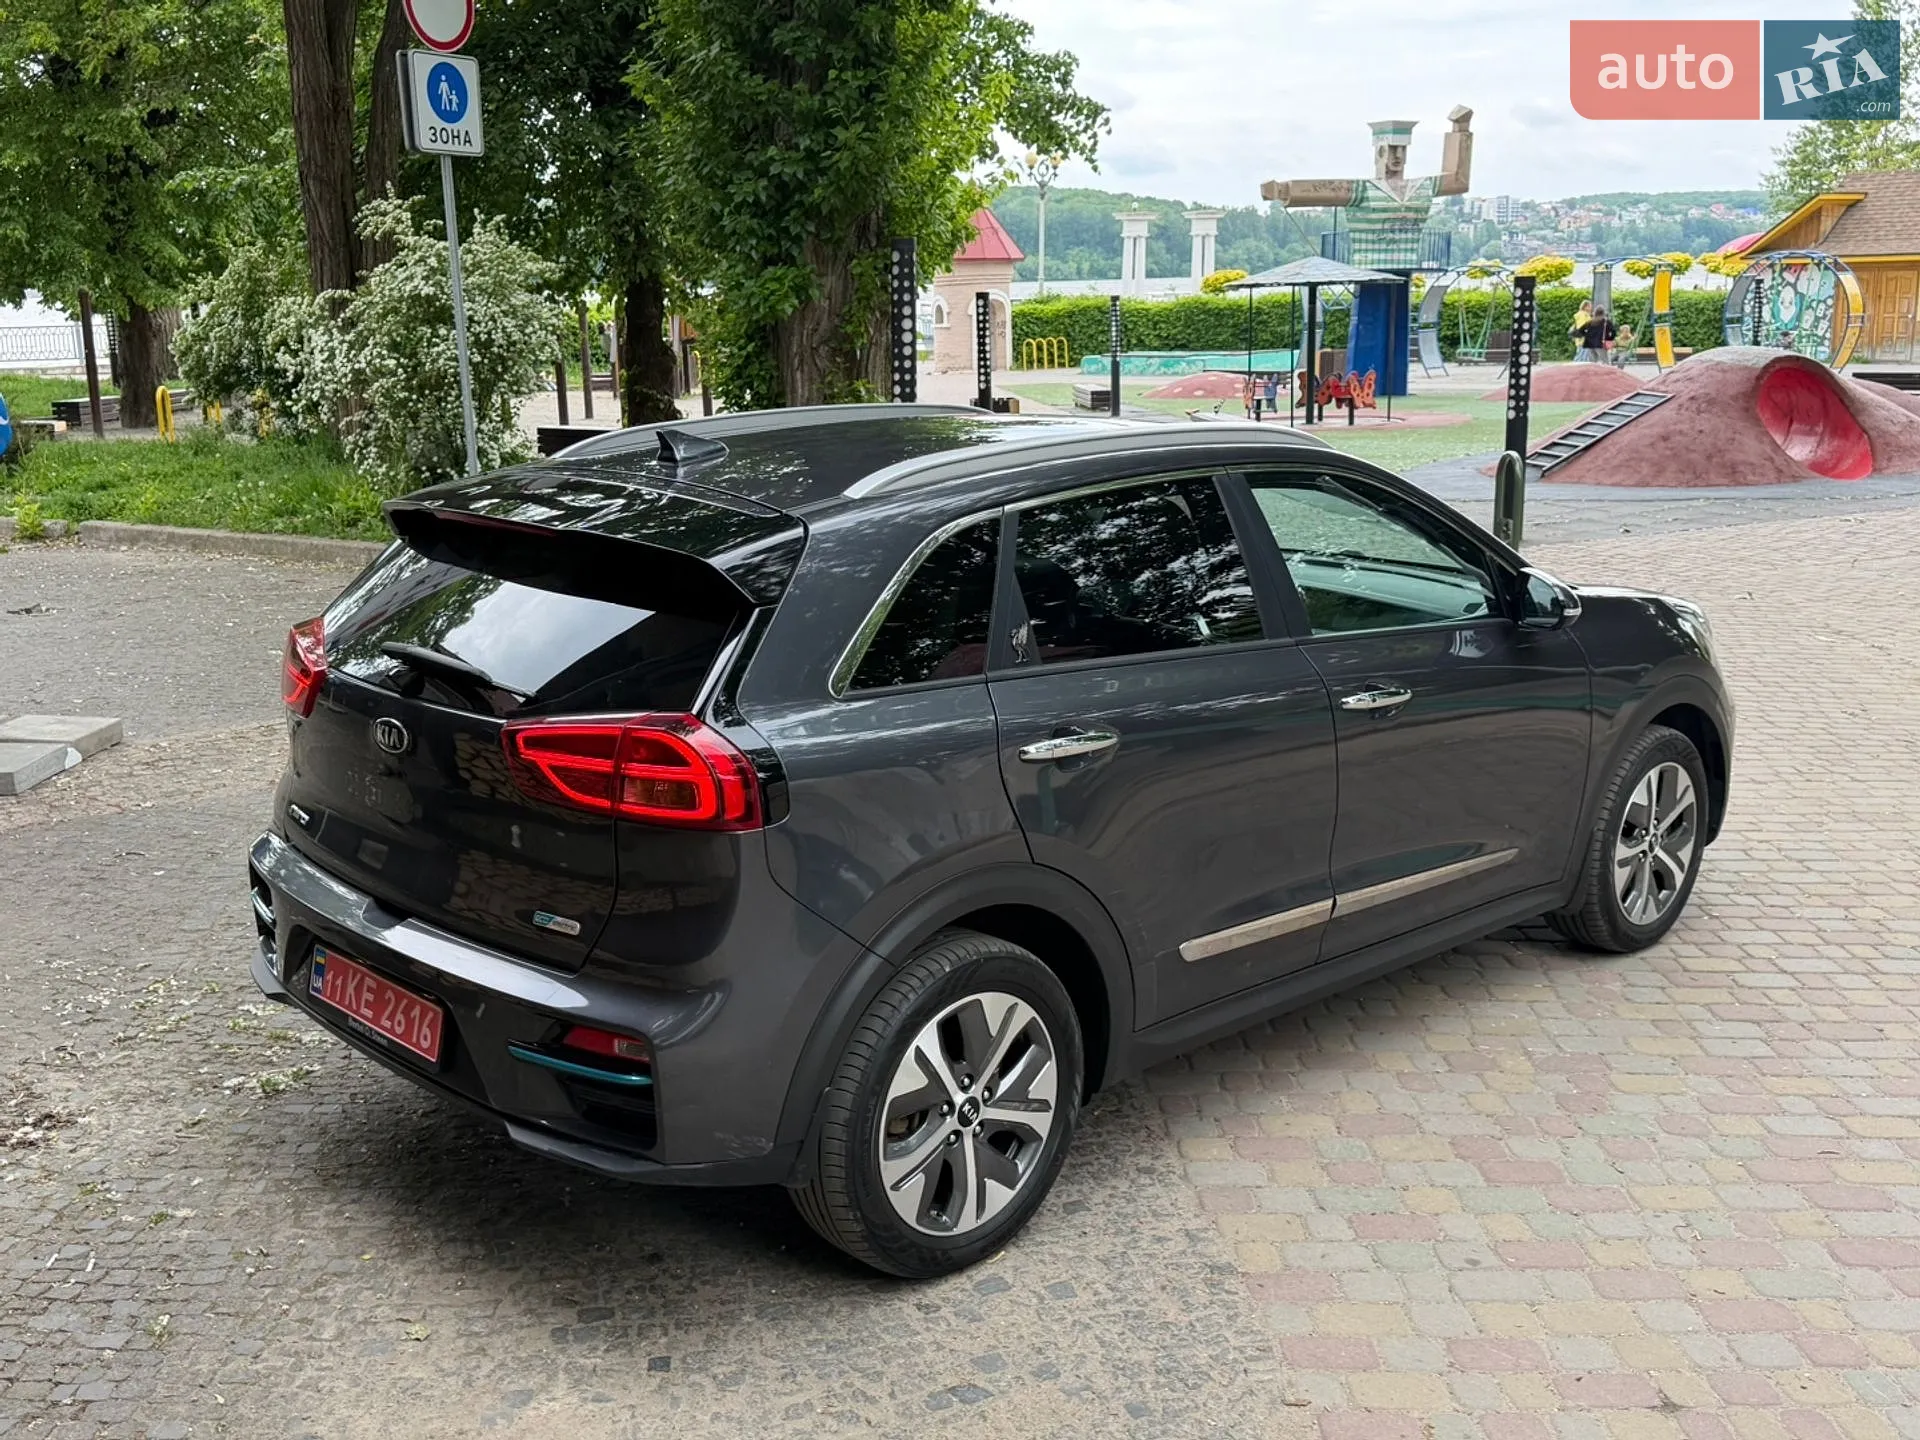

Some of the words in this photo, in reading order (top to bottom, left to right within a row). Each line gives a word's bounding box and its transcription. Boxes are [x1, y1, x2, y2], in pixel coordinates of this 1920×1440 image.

[428, 126, 473, 147] ЗОНА
[313, 974, 323, 991] UA
[381, 988, 435, 1050] 2616
[962, 1102, 979, 1123] KIA
